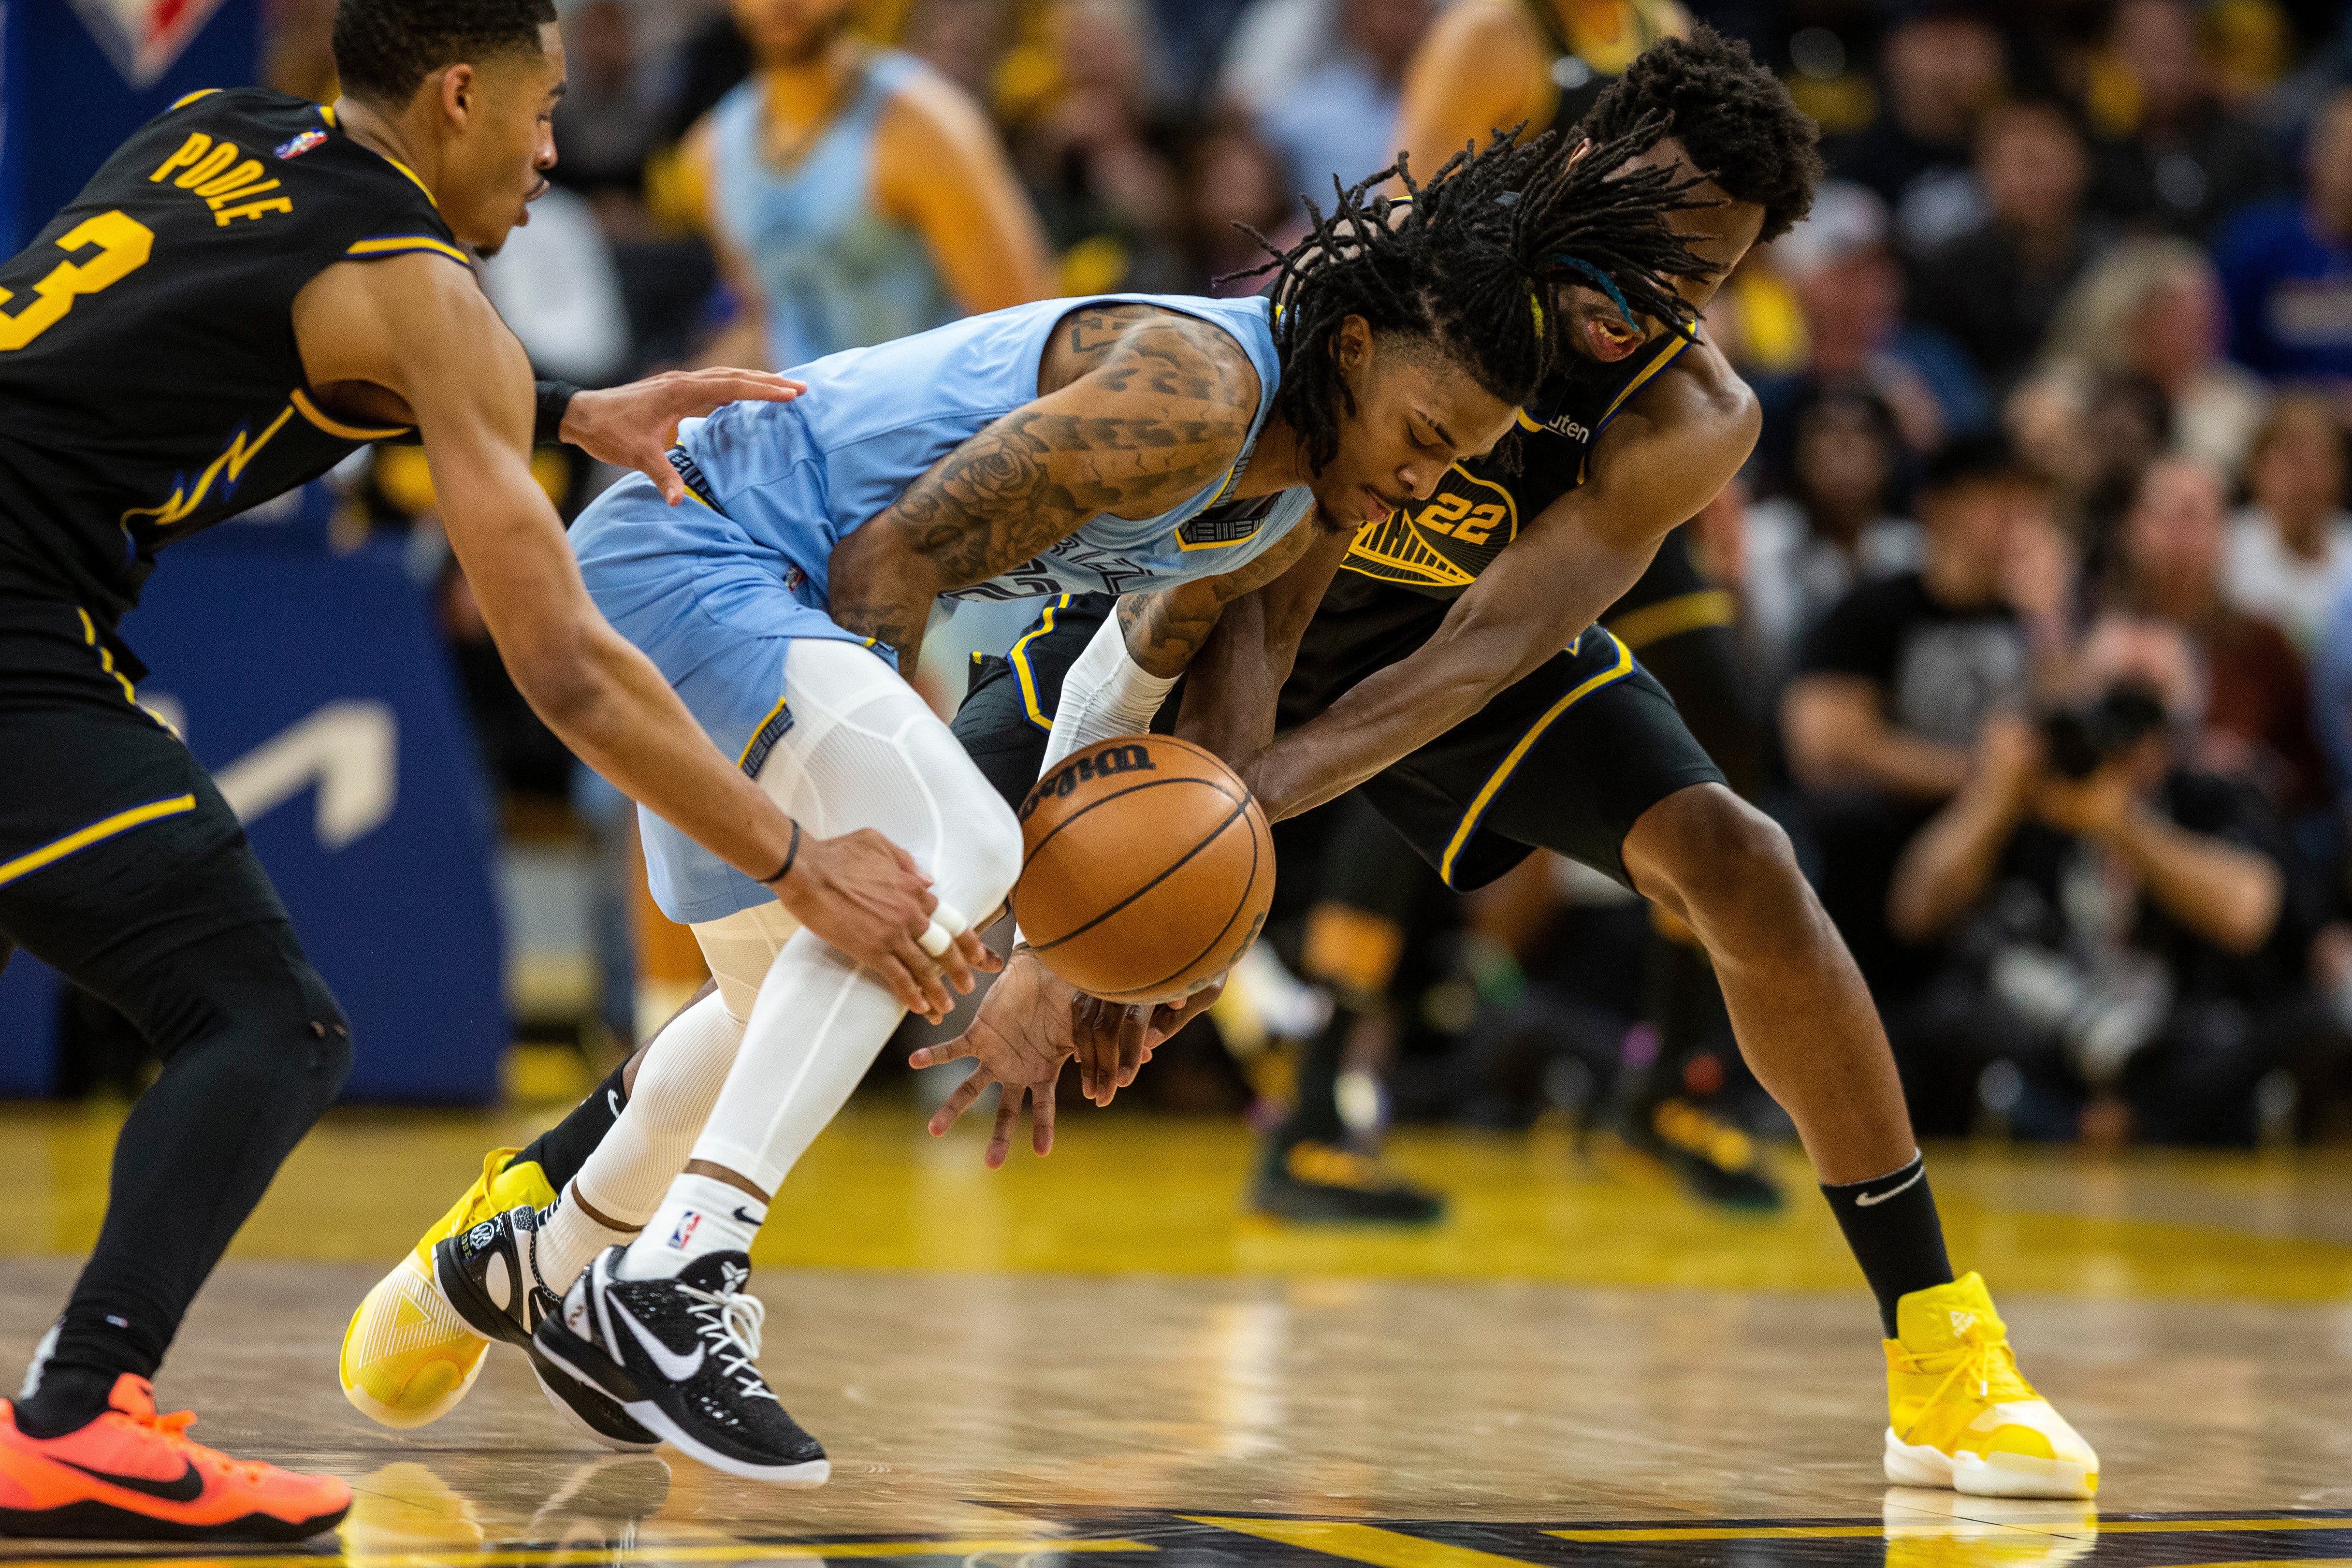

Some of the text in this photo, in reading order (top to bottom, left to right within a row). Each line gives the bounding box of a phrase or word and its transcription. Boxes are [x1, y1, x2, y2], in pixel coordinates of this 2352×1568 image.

[149, 132, 293, 227] POOLE
[0, 209, 155, 352] 3
[1548, 414, 1590, 444] uten
[1414, 492, 1507, 545] 22
[1017, 744, 1156, 823] Wilso
